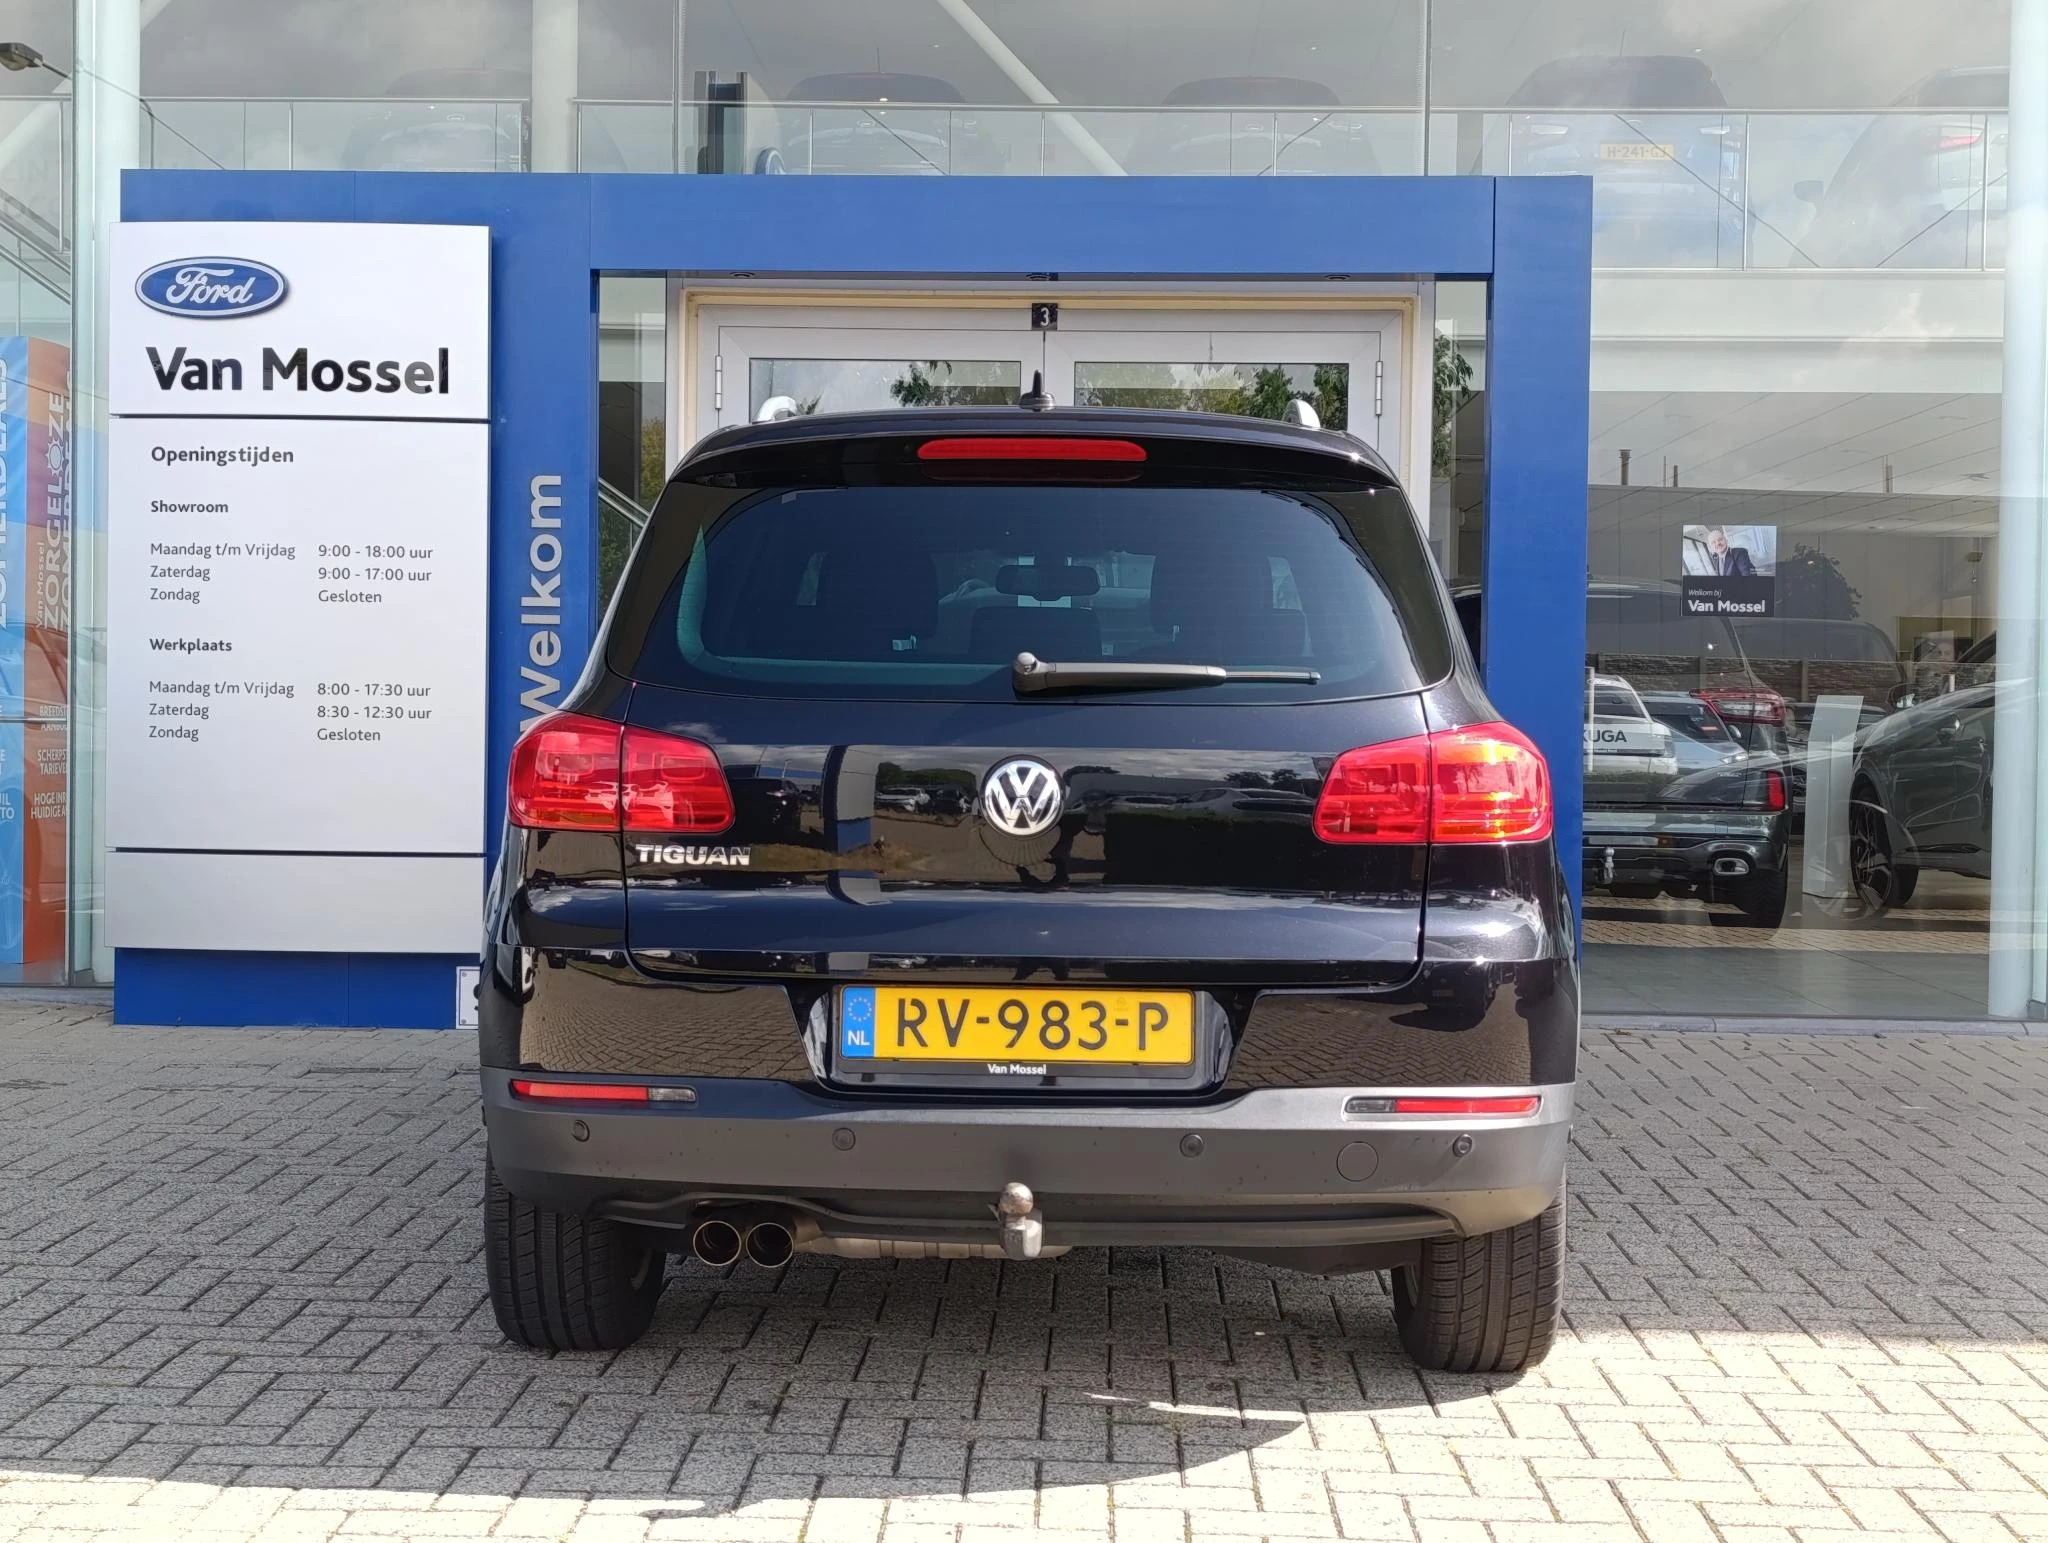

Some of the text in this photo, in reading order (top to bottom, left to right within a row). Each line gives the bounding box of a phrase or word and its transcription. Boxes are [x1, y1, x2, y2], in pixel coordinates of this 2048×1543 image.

[165, 267, 256, 304] Ford
[1040, 307, 1050, 326] 3
[145, 347, 449, 394] Van Mossel
[151, 446, 294, 467] Openingstijden
[151, 500, 229, 514] Showroom
[150, 542, 211, 559] Maandag
[215, 543, 241, 557] t/m
[245, 544, 296, 560] Vrijdag
[318, 544, 351, 558] 9:00
[365, 545, 406, 559] 18:00
[409, 549, 434, 559] uur
[150, 565, 211, 581] Zaterdag
[318, 567, 351, 580] 9:00
[365, 567, 404, 581] 17:00
[408, 571, 433, 582] uur
[150, 588, 382, 604] Zondag Gesloten
[519, 474, 562, 734] Welkom
[1688, 599, 1766, 613] Van Mossel
[149, 638, 233, 655] Werkplaats
[149, 680, 210, 697] Maandag
[214, 681, 240, 696] t/m
[244, 682, 295, 698] Vrijdag
[317, 683, 351, 696] 8:00
[364, 683, 403, 697] 17:30
[407, 687, 432, 697] uur
[149, 703, 210, 719] Zaterdag
[317, 706, 350, 719] 8:30
[364, 706, 404, 719] 12:30
[407, 710, 433, 720] uur
[149, 725, 381, 742] Zondag Gesloten
[635, 843, 752, 866] TIGUAN
[897, 997, 1168, 1051] RV-983-P
[847, 1030, 870, 1047] NL
[987, 1063, 1047, 1075] Van Mossel
